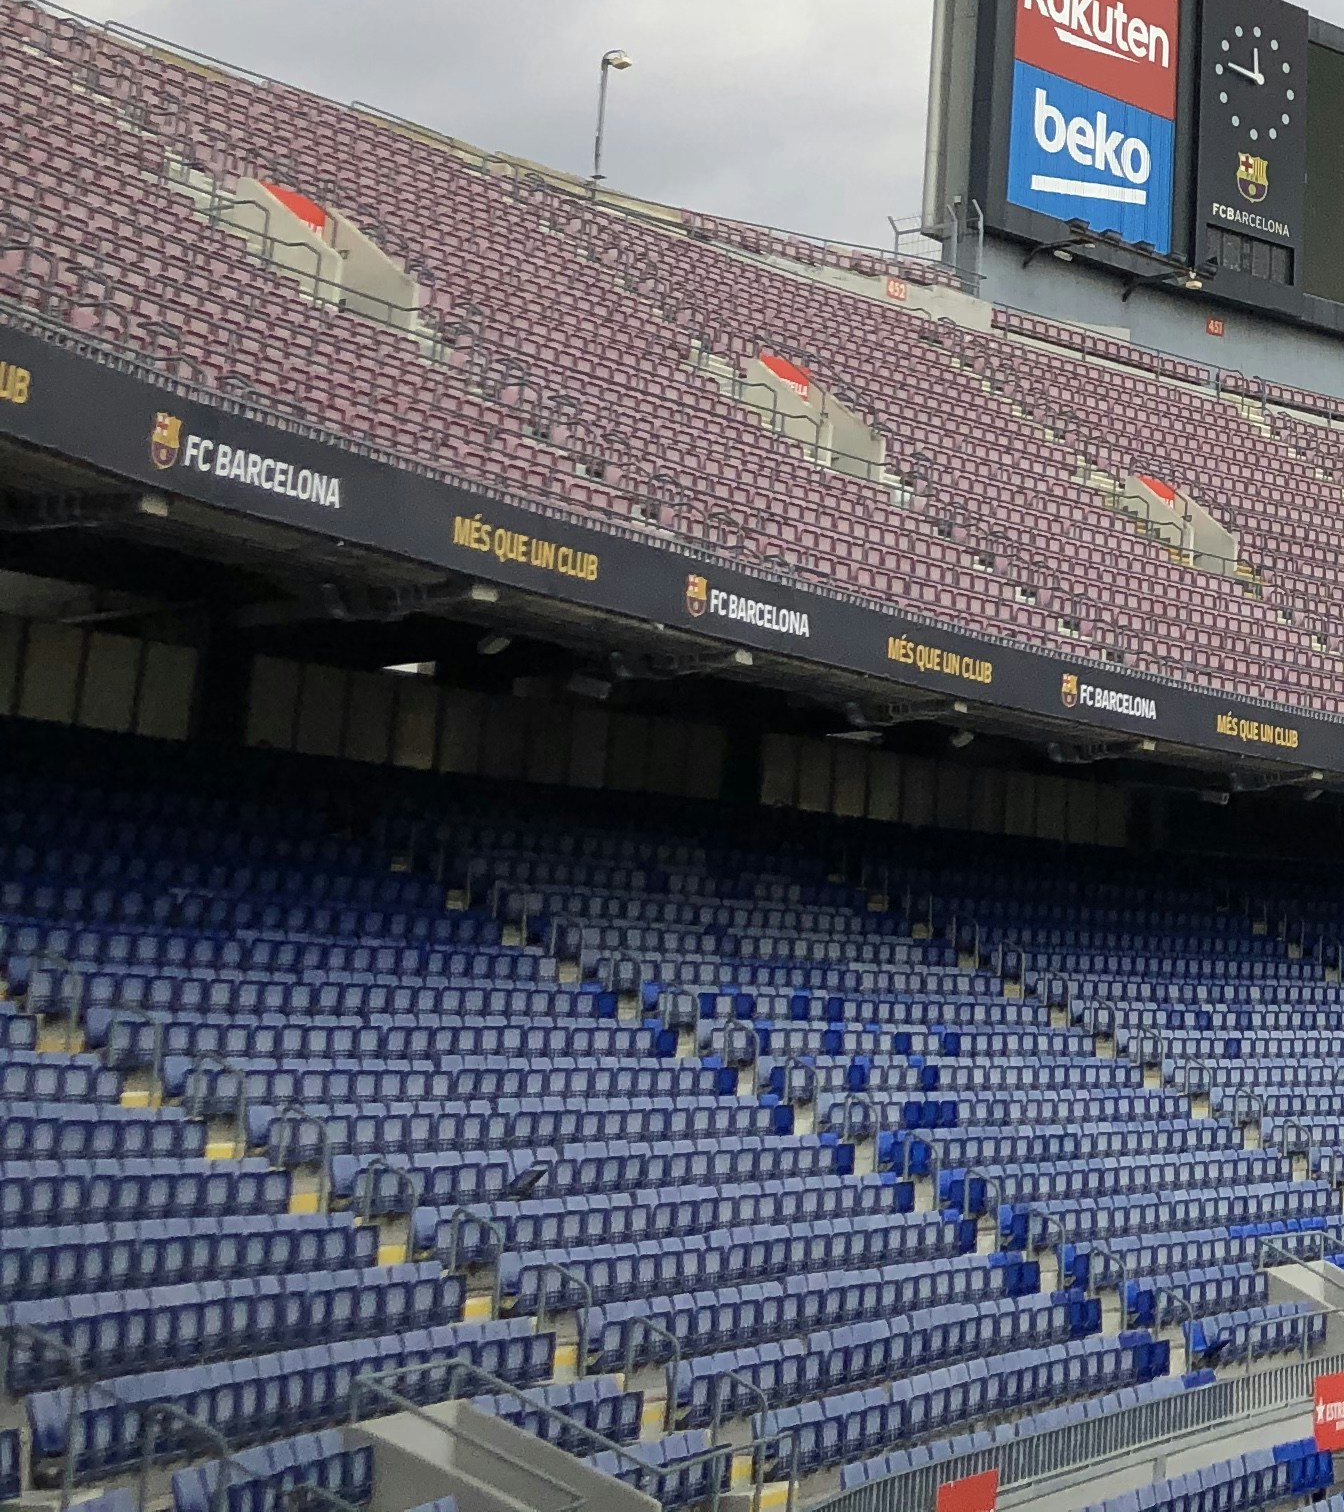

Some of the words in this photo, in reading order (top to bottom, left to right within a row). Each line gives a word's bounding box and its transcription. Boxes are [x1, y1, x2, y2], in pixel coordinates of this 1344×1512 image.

[1034, 88, 1151, 185] beko
[887, 279, 906, 298] 452
[1208, 320, 1223, 334] 451
[184, 434, 214, 472] FC
[214, 442, 340, 509] BARCELONA
[453, 514, 491, 551] MÉS
[494, 528, 527, 564] QUE
[530, 539, 556, 570] UN
[557, 546, 598, 582] CLUB
[709, 588, 727, 616] FC
[727, 593, 810, 638] BARCELONA
[916, 644, 942, 674] QUE
[943, 652, 960, 676] UN
[961, 657, 993, 684] CLUB
[1079, 684, 1095, 708] FC
[1095, 688, 1157, 719] BARCELONA
[1239, 719, 1259, 743] QUE
[1260, 724, 1274, 742] UN
[1274, 727, 1298, 748] CLUB
